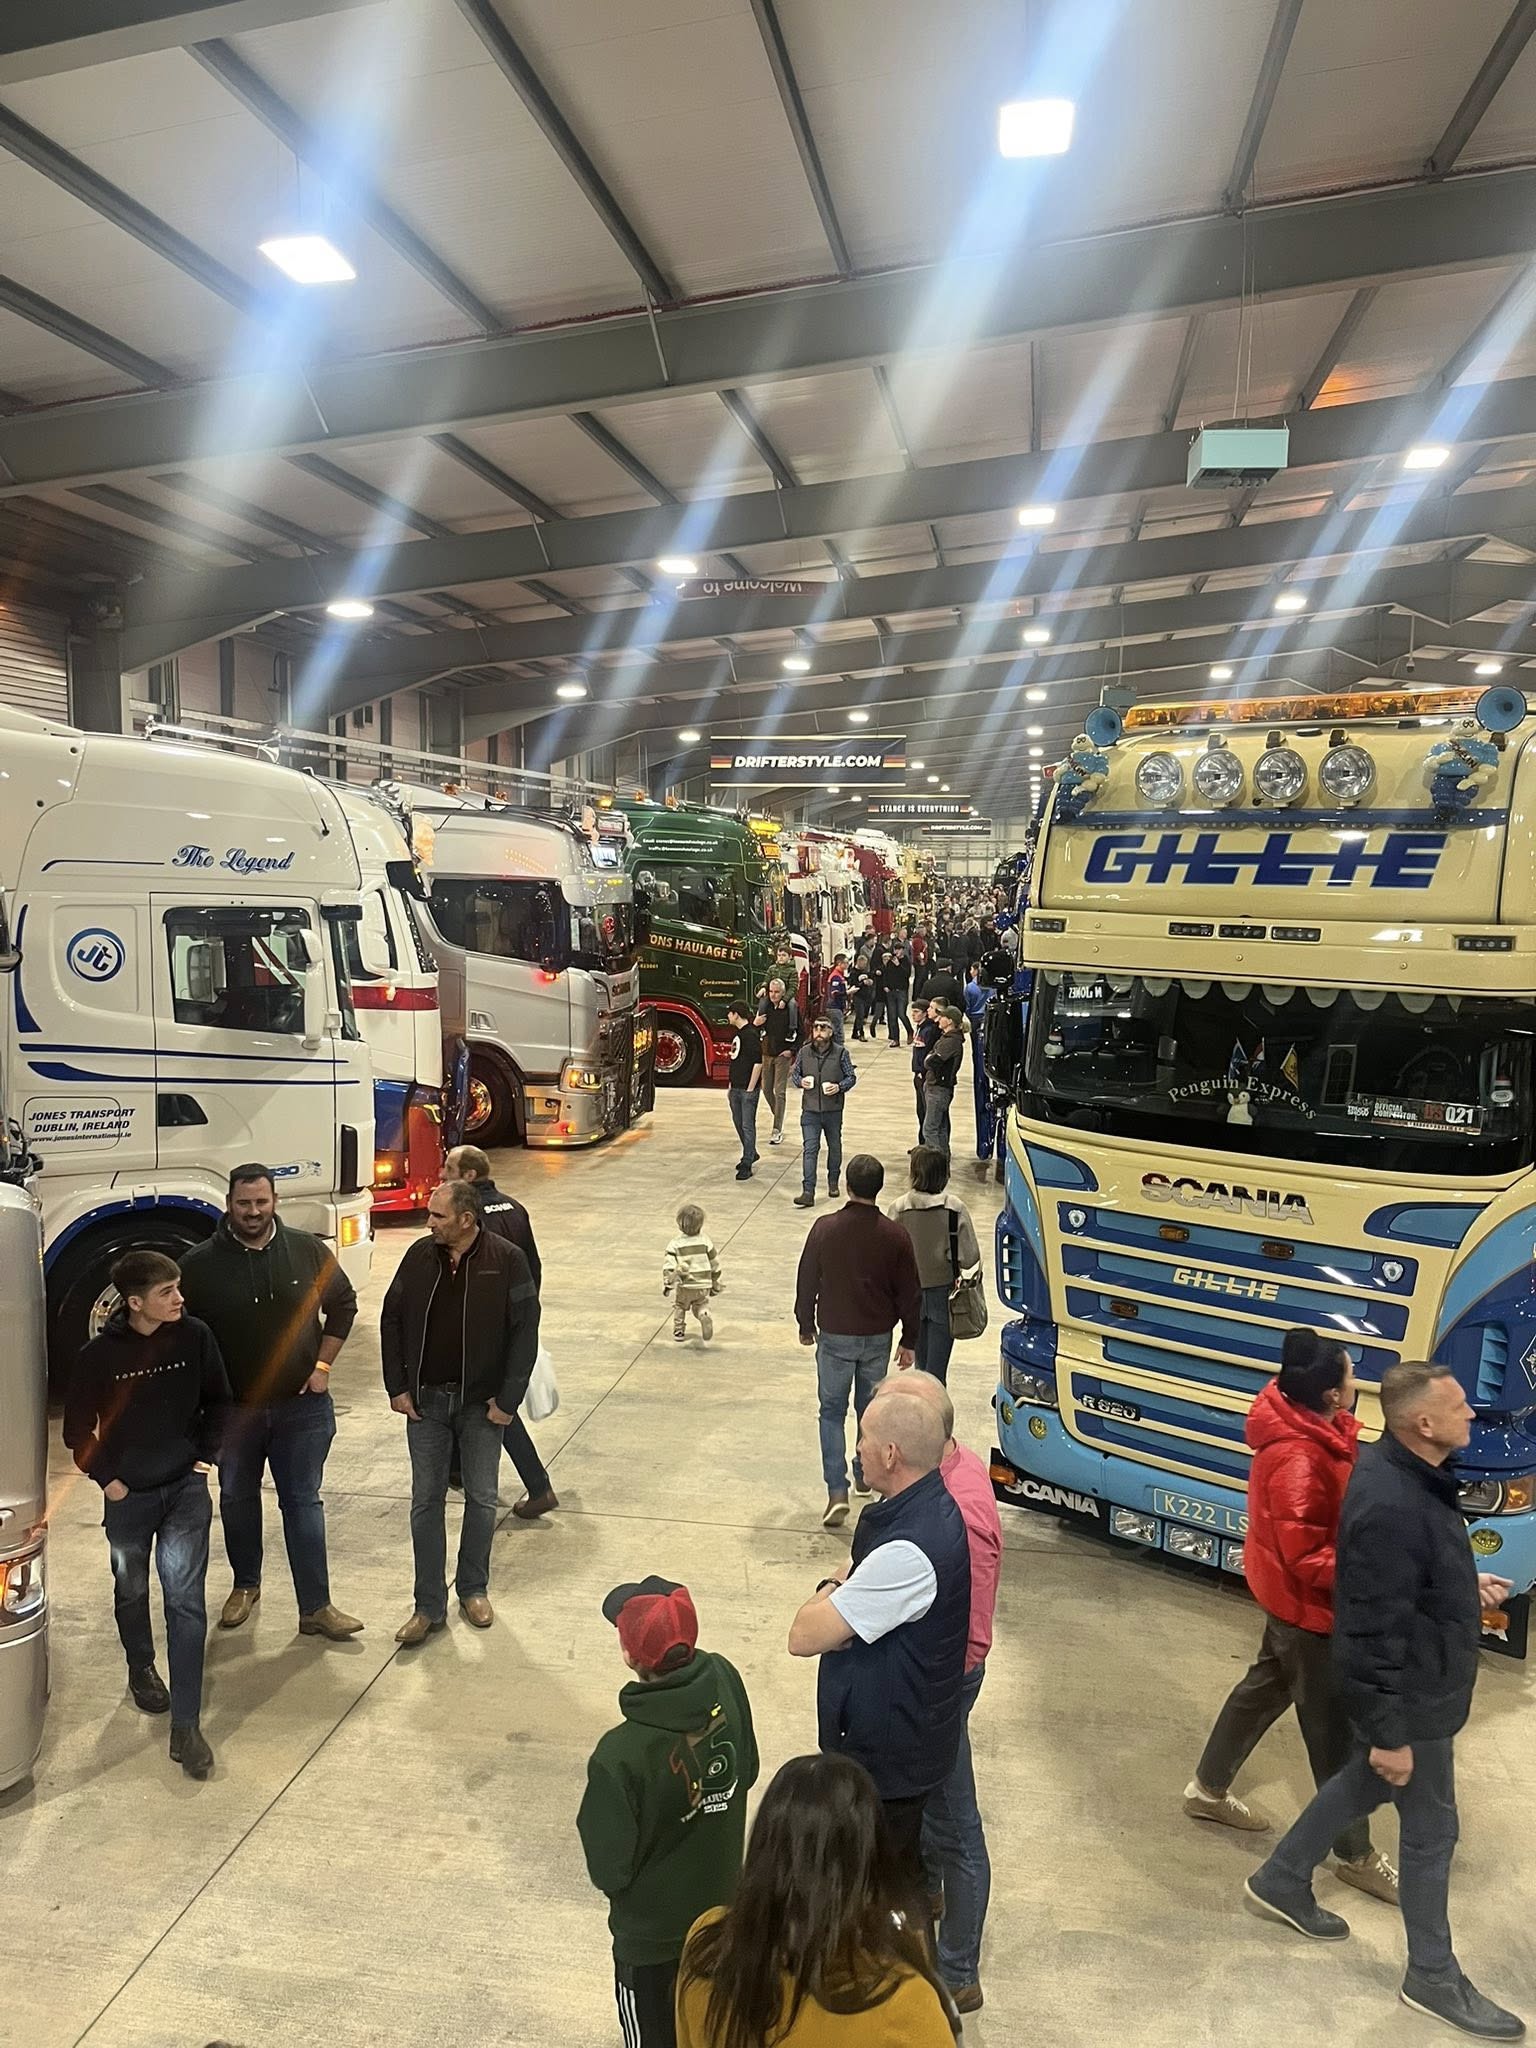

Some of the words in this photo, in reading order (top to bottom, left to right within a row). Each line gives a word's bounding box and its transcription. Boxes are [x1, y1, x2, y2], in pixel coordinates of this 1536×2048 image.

[734, 754, 882, 769] DRIFTERSTYLE.COM
[908, 804, 915, 813] IS
[917, 804, 960, 813] EVERYTHING
[171, 844, 215, 868] The
[219, 847, 295, 875] Legend
[649, 934, 673, 948] ONS
[675, 938, 728, 959] HAULAGE
[1168, 1074, 1240, 1103] Penguin
[1247, 1075, 1316, 1120] Express
[1374, 1102, 1403, 1112] OFFICIAL
[28, 1111, 67, 1121] JONES
[70, 1108, 136, 1119] TRANSPORT
[34, 1123, 79, 1132] DUBLIN,
[82, 1120, 130, 1130] IRELAND
[1140, 1172, 1315, 1225] SCANIA
[1164, 1494, 1216, 1525] K222
[1226, 1511, 1249, 1533] LS
